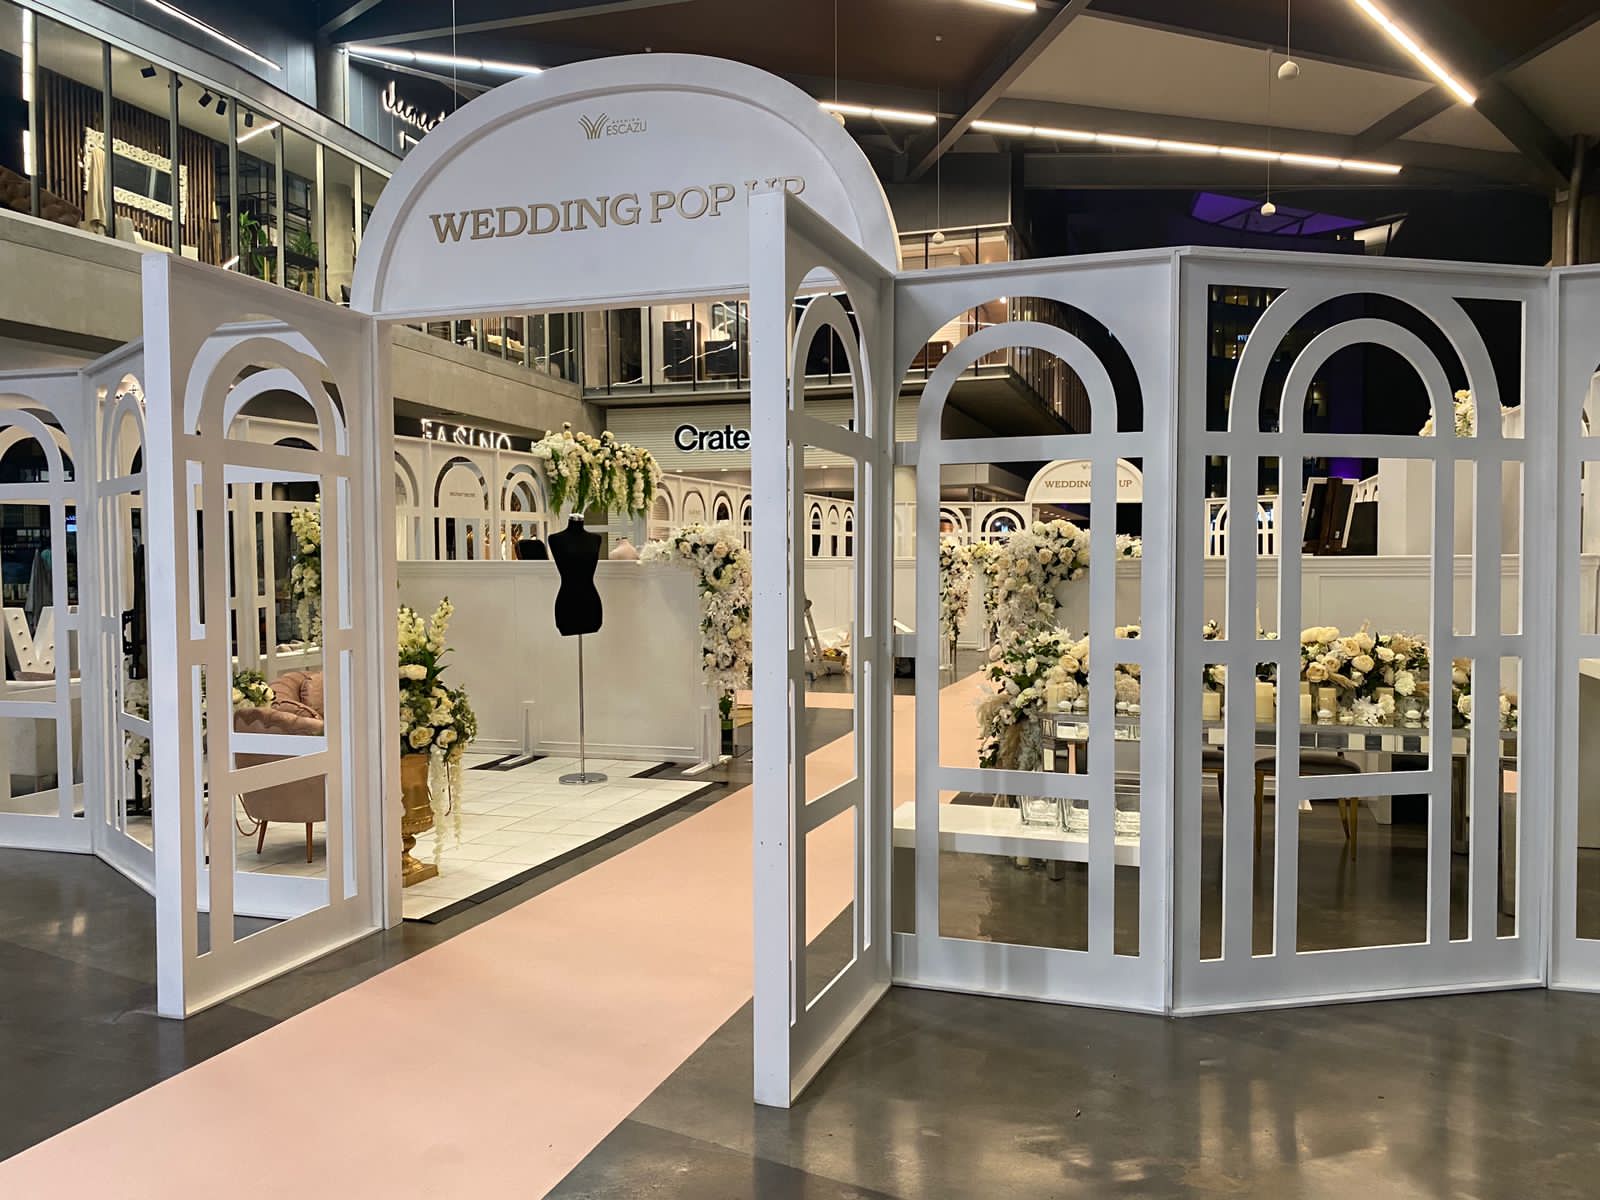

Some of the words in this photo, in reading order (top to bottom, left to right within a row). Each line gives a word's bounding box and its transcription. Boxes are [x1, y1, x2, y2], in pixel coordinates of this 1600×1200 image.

[429, 193, 642, 243] WEDDING
[649, 183, 736, 223] POP
[744, 175, 806, 208] P
[674, 424, 750, 451] Crate
[1118, 479, 1133, 488] UP
